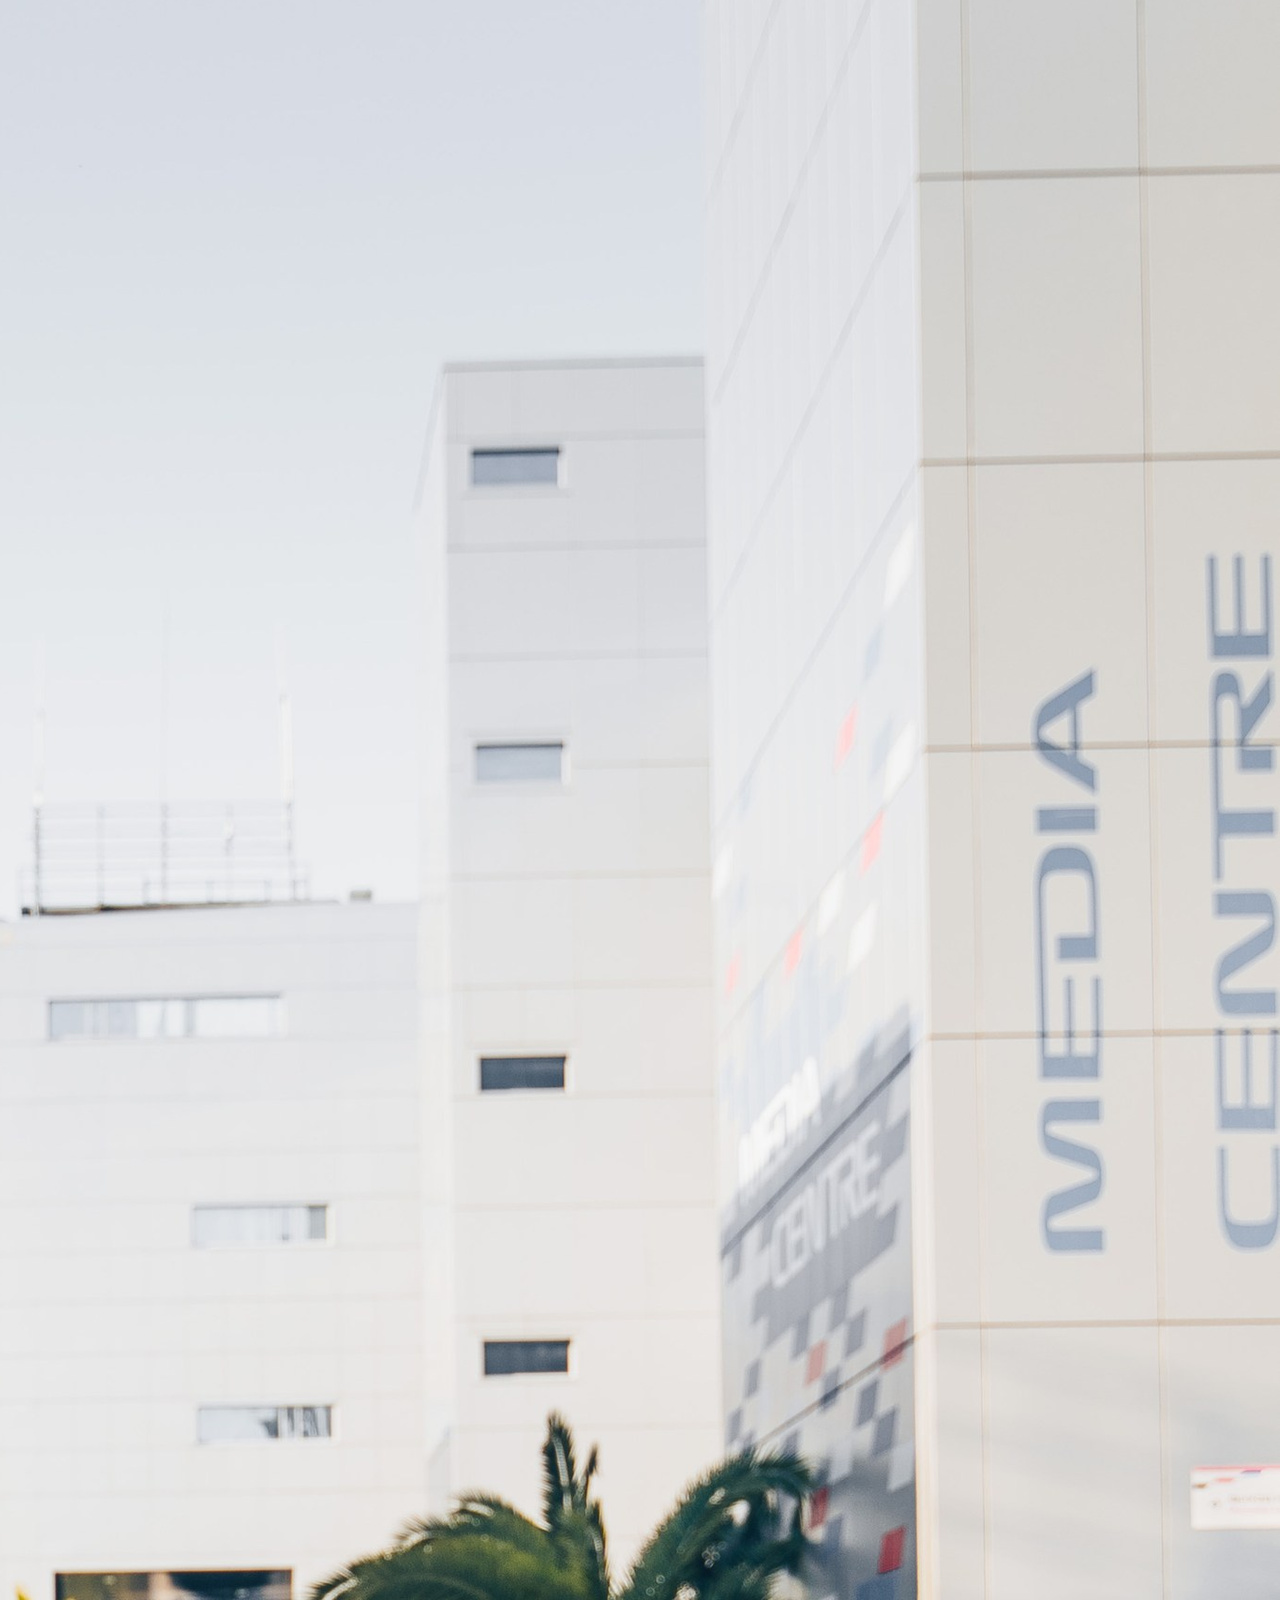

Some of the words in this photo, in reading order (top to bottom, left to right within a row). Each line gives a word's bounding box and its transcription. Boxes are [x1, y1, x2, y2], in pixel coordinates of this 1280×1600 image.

[1033, 666, 1106, 1253] MEDIA
[1206, 552, 1280, 1250] CENTRE
[770, 1121, 882, 1289] CENTRE
